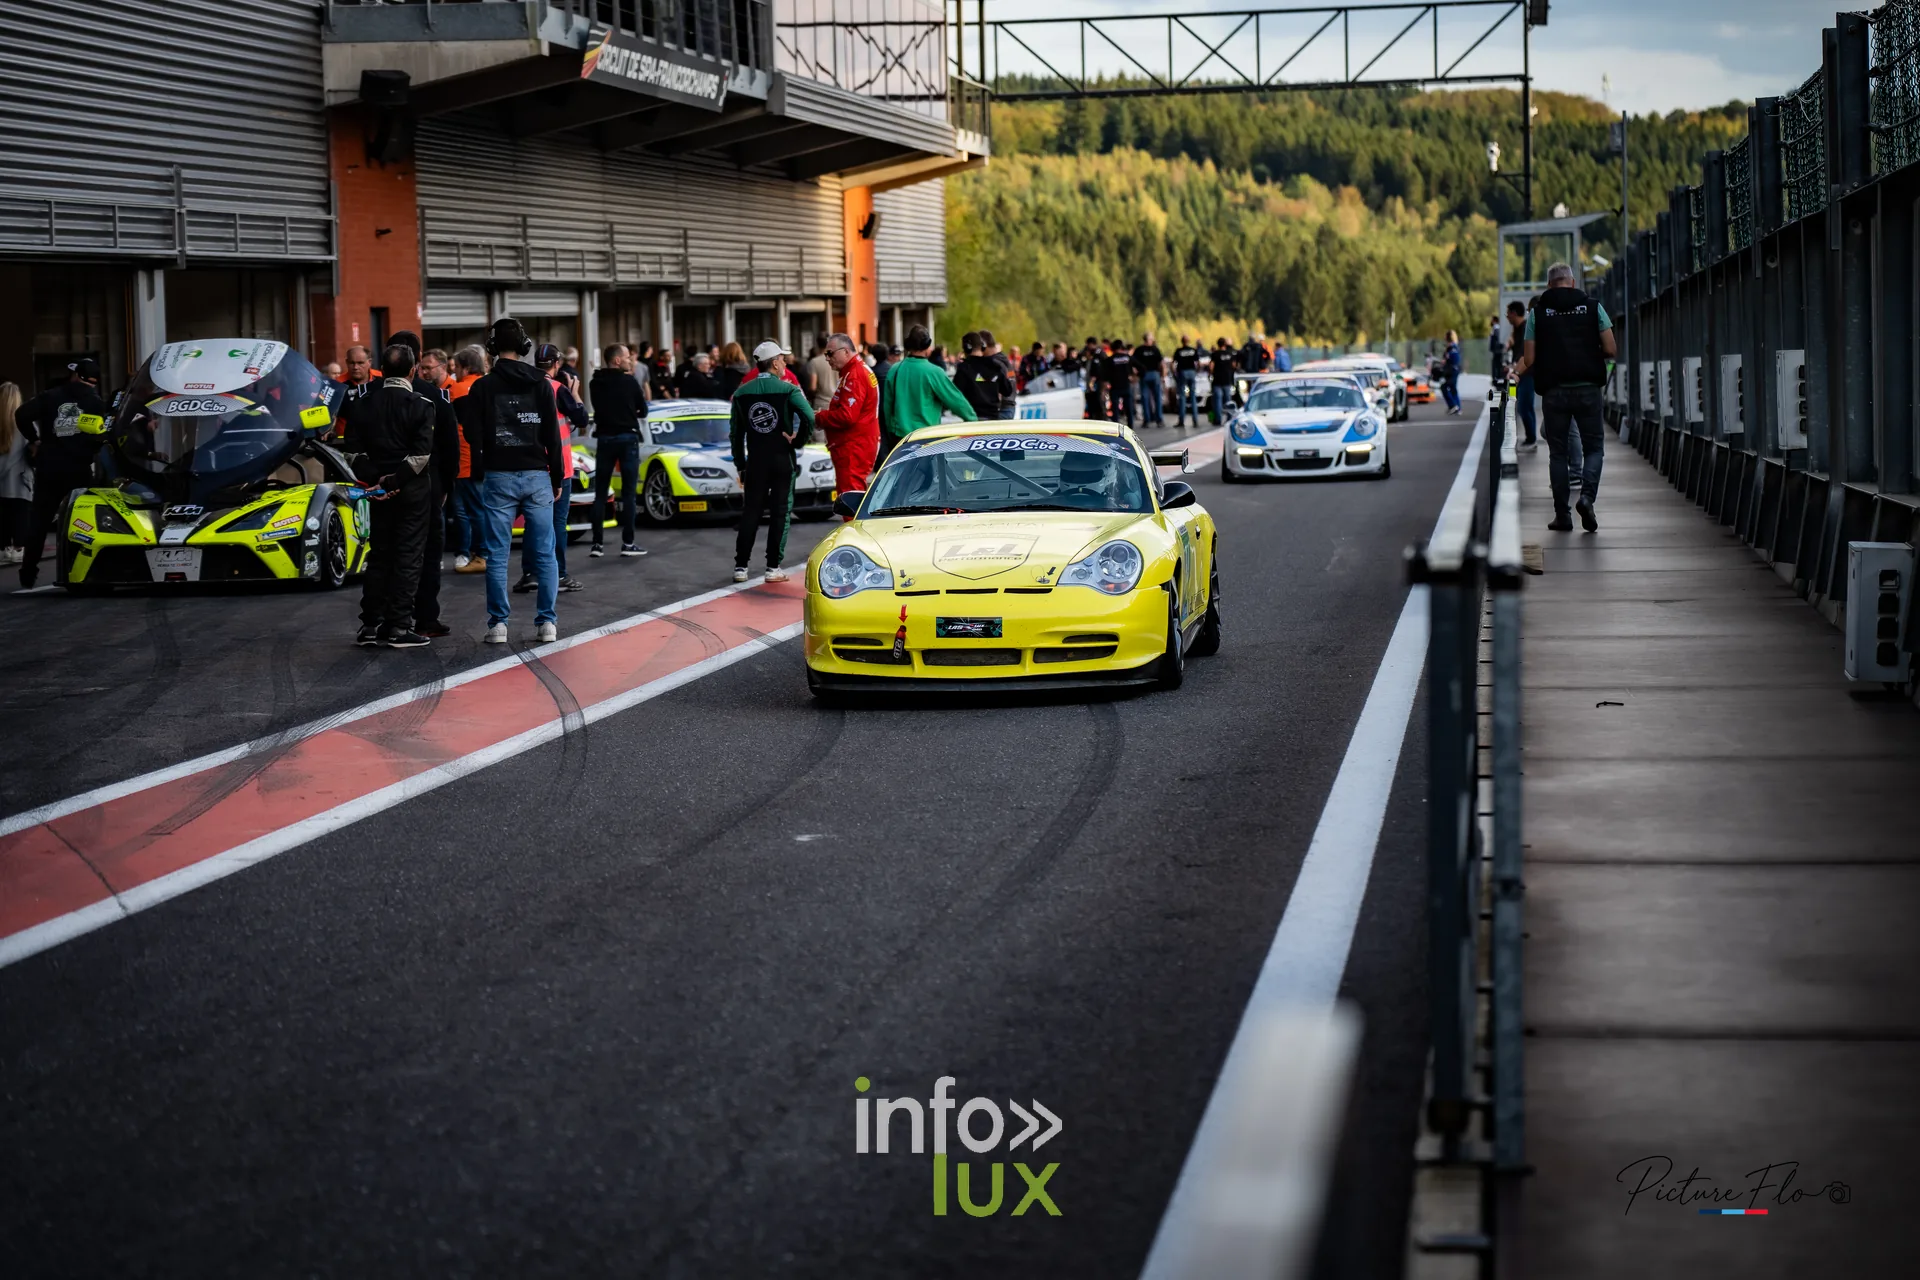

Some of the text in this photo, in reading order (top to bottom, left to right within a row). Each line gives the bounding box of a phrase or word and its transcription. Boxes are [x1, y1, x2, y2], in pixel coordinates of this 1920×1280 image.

[626, 51, 641, 79] DE
[166, 399, 227, 414] BGDC.be
[650, 421, 675, 434] 50
[969, 439, 1059, 451] BGDC.be
[162, 505, 203, 516] KTM
[273, 516, 301, 528] MOTUL
